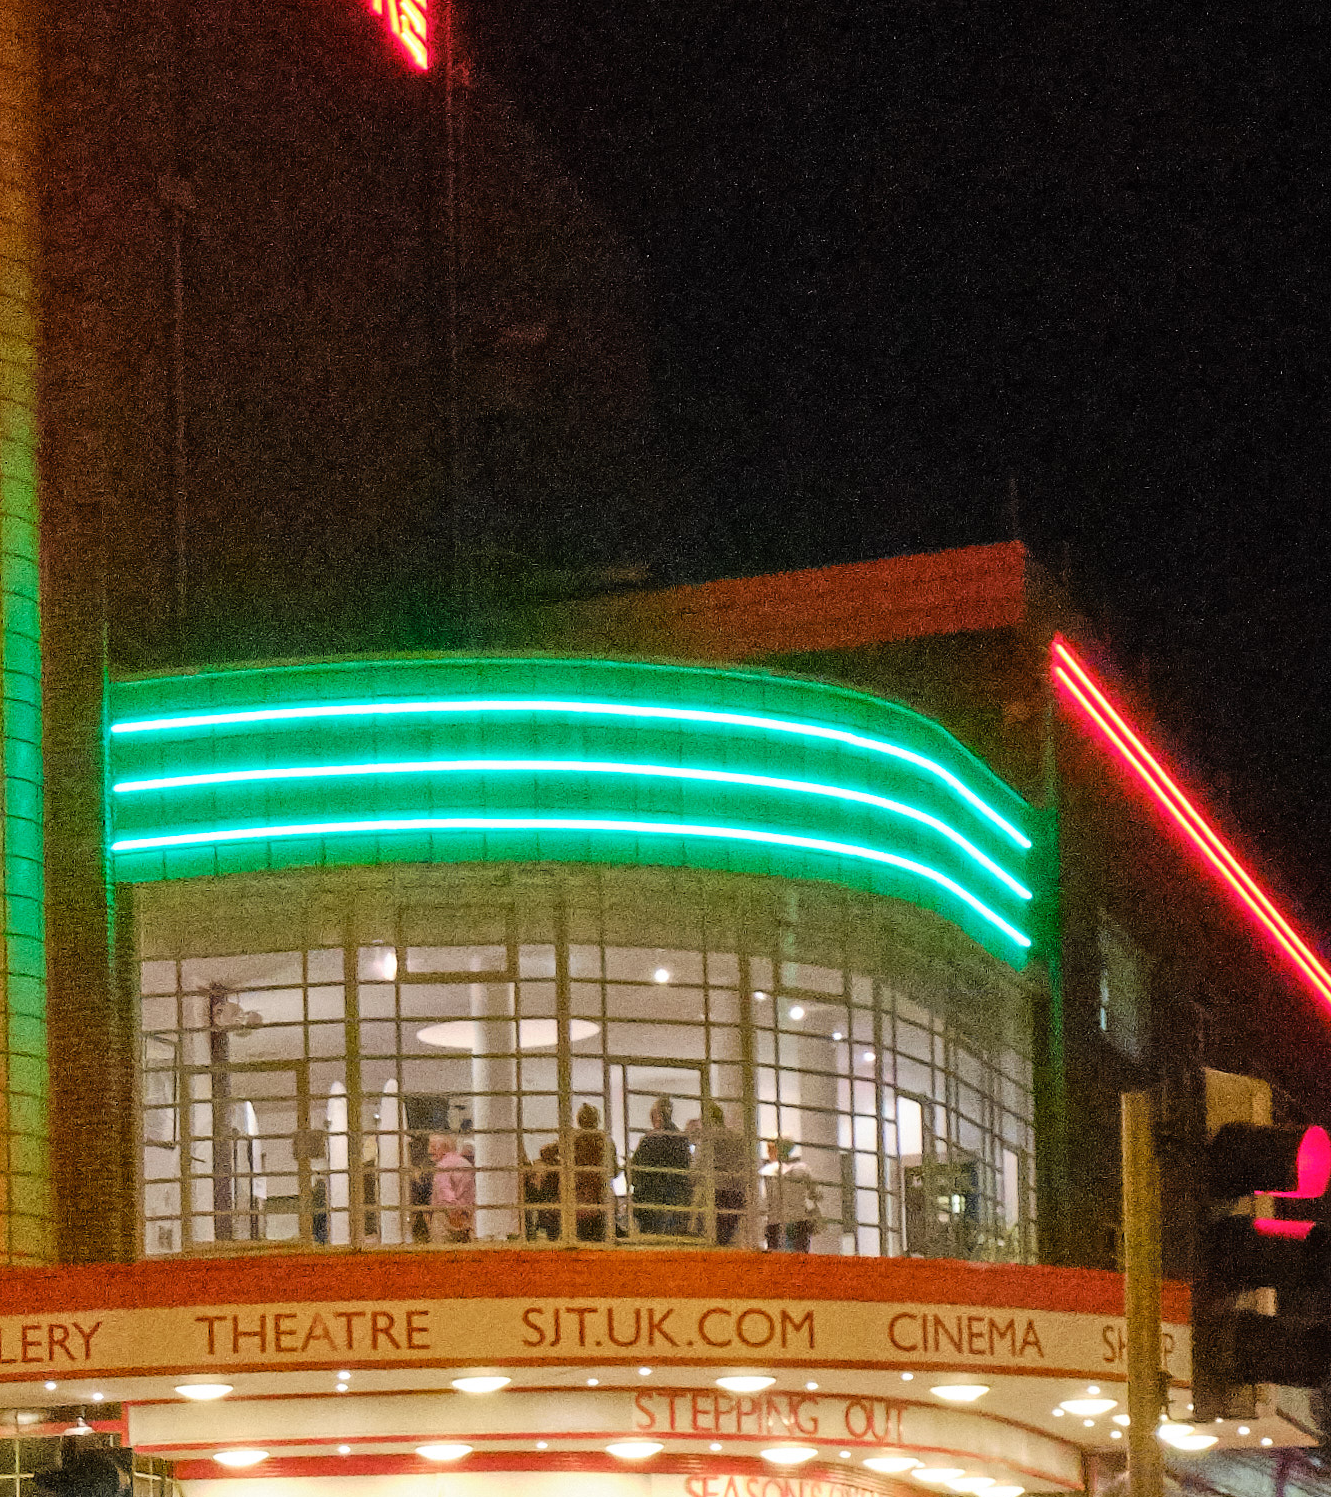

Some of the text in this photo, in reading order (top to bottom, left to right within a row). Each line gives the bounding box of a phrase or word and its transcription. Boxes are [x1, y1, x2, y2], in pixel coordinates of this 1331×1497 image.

[195, 1309, 431, 1355] THEATRE
[521, 1307, 817, 1350] SJT.UK.COM
[888, 1312, 1045, 1358] CINEMA
[1102, 1325, 1175, 1368] SP
[635, 1391, 911, 1444] STEPPING OUT
